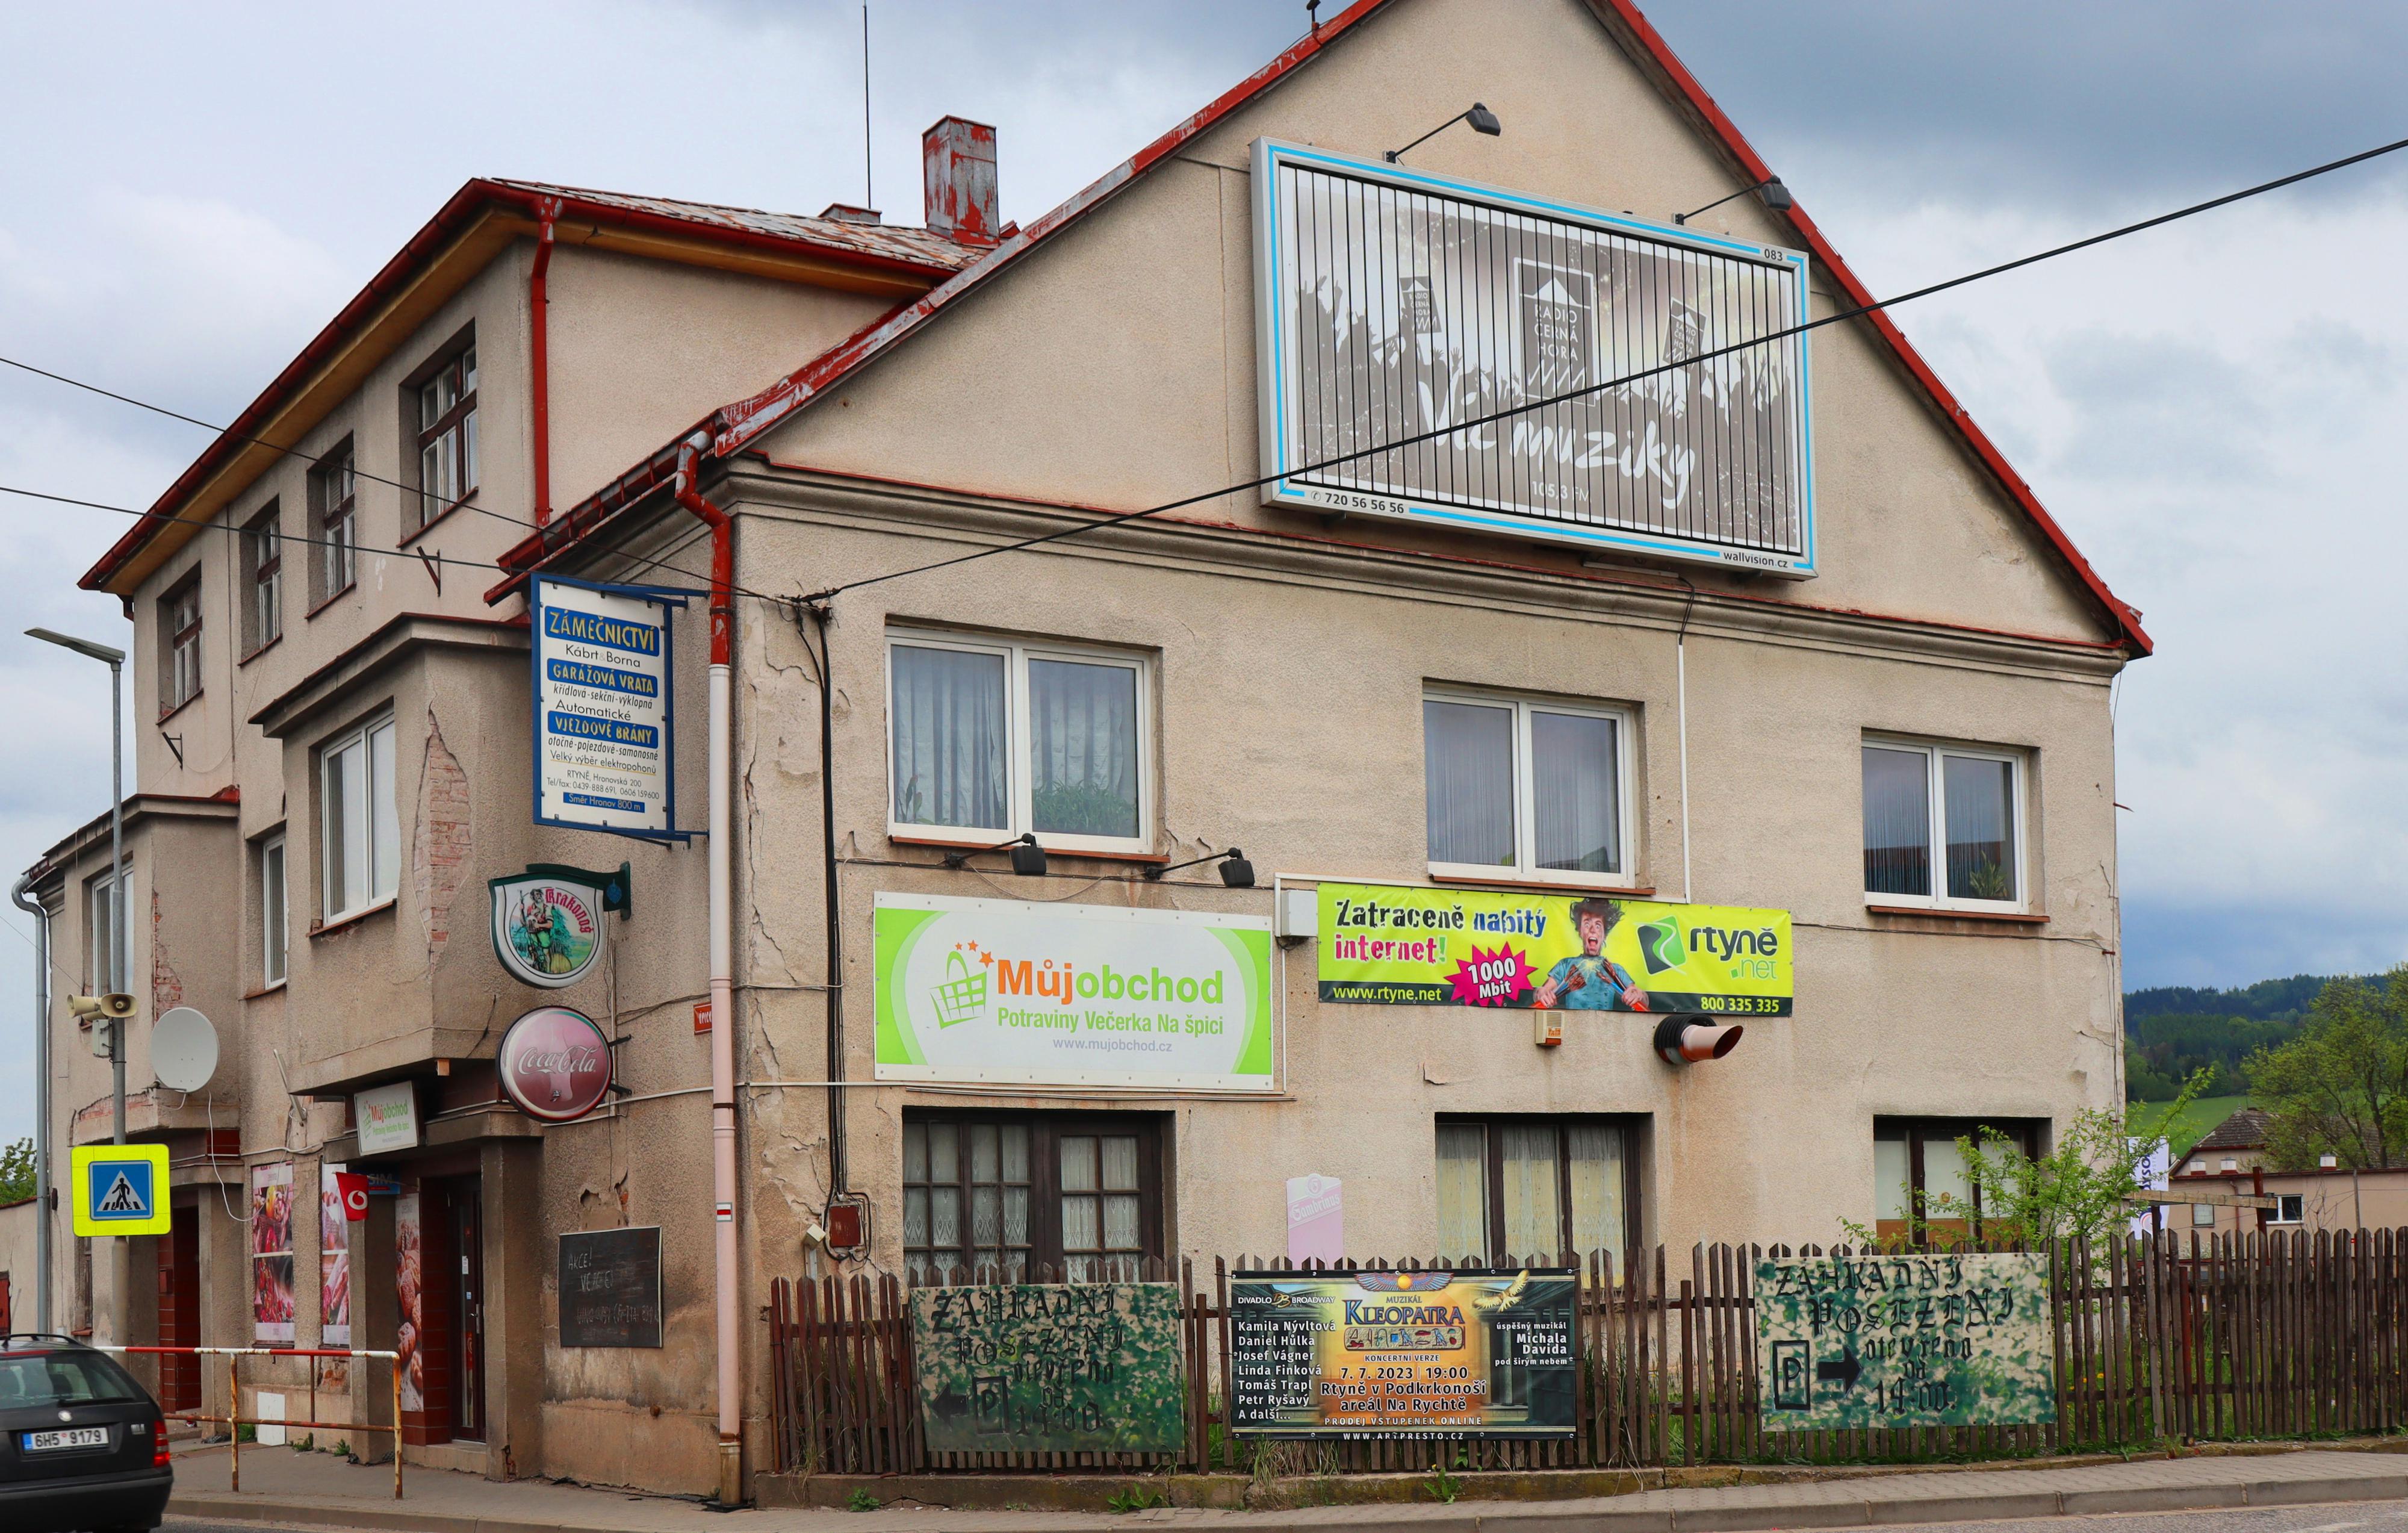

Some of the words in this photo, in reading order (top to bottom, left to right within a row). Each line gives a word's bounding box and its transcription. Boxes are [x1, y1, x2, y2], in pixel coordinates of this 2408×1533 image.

[1764, 249, 1783, 261] 083
[1534, 304, 1577, 323] RADIO
[1534, 320, 1578, 343] ČERNÁ
[1538, 341, 1578, 361] HORA
[1509, 420, 1695, 509] muziky
[1531, 480, 1568, 500] 105,3
[1572, 486, 1589, 502] FM
[1326, 493, 1347, 505] 720
[1352, 497, 1367, 508] 56
[1371, 500, 1385, 511] 56
[1389, 502, 1404, 513] 56
[1724, 552, 1788, 568] wallvision.cz
[550, 610, 654, 651] ZÁMEČNICTVÍ
[565, 644, 598, 660] Kábrt
[607, 651, 640, 667] Borna
[553, 664, 615, 687] GARÁŽOVÁ
[619, 674, 653, 694] VRATA
[556, 700, 631, 721] Automatické
[555, 716, 612, 738] VJEZDOVÉ
[616, 724, 652, 744] BRÁNY
[550, 750, 573, 763] Velký
[576, 753, 598, 765] výběr
[601, 757, 656, 774] elektropohonů
[567, 770, 591, 782] RTYNĚ,
[593, 774, 627, 786] Hronovská
[569, 794, 588, 804] Směr
[589, 797, 616, 807] Hronov
[617, 800, 633, 810] 800
[1336, 900, 1465, 930] Zatraceně
[1472, 909, 1547, 938] nabitý
[1335, 934, 1446, 963] internet!
[1690, 927, 1778, 961] rtyně
[1467, 957, 1516, 984] 1000
[997, 959, 1223, 1005] Můjobchod
[1479, 981, 1511, 999] Mbit
[1333, 986, 1442, 1003] www.rtyne.net
[1701, 997, 1725, 1010] 800
[1728, 998, 1752, 1012] 335
[1756, 998, 1780, 1012] 335
[998, 1006, 1079, 1033] Potraviny
[1084, 1010, 1152, 1033] Večerka
[1157, 1014, 1179, 1033] Na
[1185, 1014, 1223, 1037] špici
[1052, 1037, 1172, 1054] www.mujobchod.cz
[371, 1099, 408, 1124] Můjobchod
[1291, 1194, 1340, 1221] Gambrinus
[568, 1246, 592, 1270] AKCE!
[1775, 1255, 1963, 1298] ZAHRADNÍ
[930, 1284, 1116, 1334] ZAHRADNÍ
[1342, 1299, 1465, 1325] KLEOPATRA
[1238, 1320, 1279, 1331] Kamila
[1283, 1320, 1336, 1333] Nývltová
[1497, 1322, 1531, 1331] úspěšný
[1238, 1336, 1277, 1346] Daniel
[1281, 1334, 1315, 1346] Hůlka
[1516, 1332, 1567, 1343] Michala
[1238, 1351, 1269, 1362] Josef
[1273, 1351, 1315, 1362] Vágner
[1365, 1353, 1412, 1362] KONCERTNÍ
[1522, 1343, 1567, 1354] Davida
[1238, 1365, 1271, 1375] Linda
[1276, 1365, 1322, 1375] Finková
[1513, 1357, 1536, 1366] širým
[1903, 1360, 1926, 1381] od
[1340, 1367, 1353, 1379] 7.
[1359, 1367, 1371, 1379] 7.
[1377, 1367, 1413, 1379] 2023
[1426, 1367, 1468, 1379] 19:00
[1783, 1357, 1801, 1392] P
[1238, 1379, 1277, 1390] Tomáš
[1281, 1380, 1312, 1392] Trapl
[1321, 1381, 1367, 1398] Rtyně
[1371, 1384, 1380, 1395] v
[1385, 1380, 1486, 1396] Podkrkonoší
[981, 1388, 997, 1418] P
[1238, 1395, 1264, 1405] Petr
[1268, 1395, 1309, 1407] Ryšavý
[1340, 1397, 1382, 1411] areál
[1387, 1398, 1406, 1411] Na
[1412, 1398, 1466, 1414] Rychtě
[1238, 1411, 1246, 1419] A
[1250, 1409, 1291, 1420] další...
[1324, 1417, 1367, 1426] PRODEJ
[1371, 1417, 1435, 1425] VSTUPENEK
[35, 1433, 60, 1447] 6H5
[70, 1429, 101, 1444] 9179
